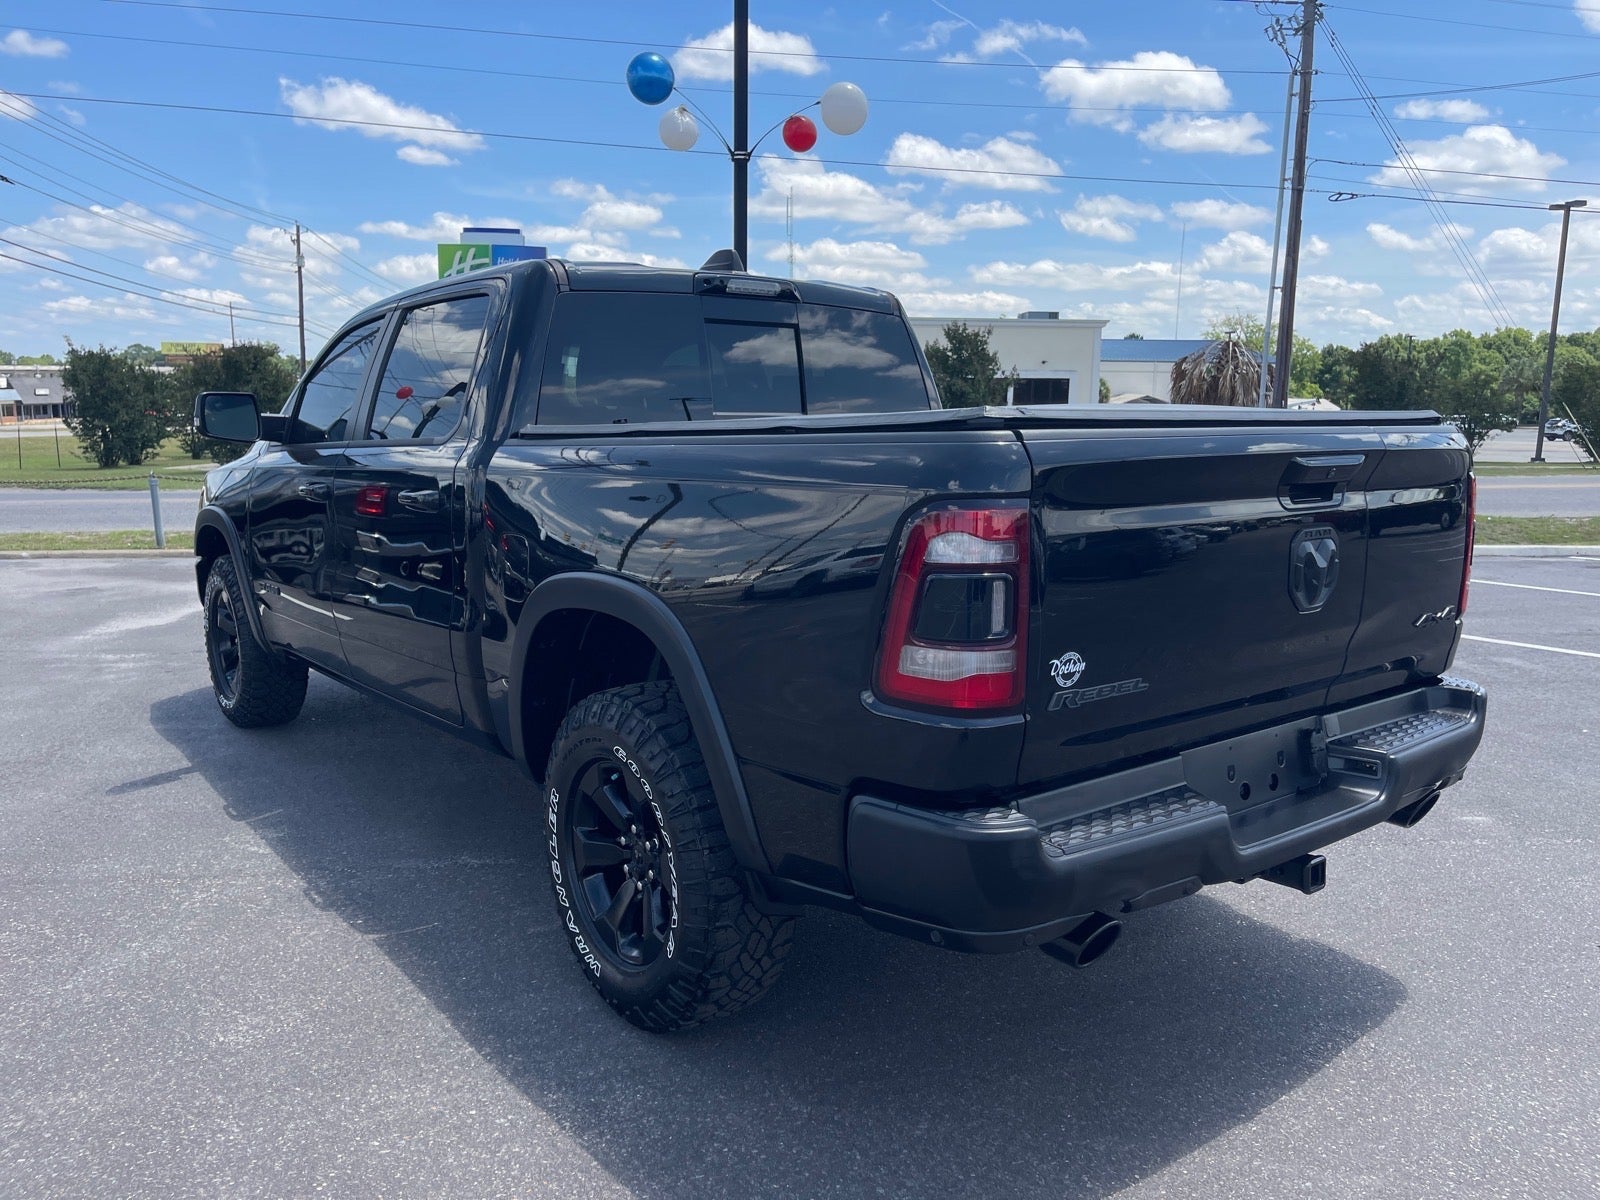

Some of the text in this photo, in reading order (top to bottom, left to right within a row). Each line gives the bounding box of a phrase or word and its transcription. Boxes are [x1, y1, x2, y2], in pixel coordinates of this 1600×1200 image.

[1304, 528, 1332, 538] RAM
[1048, 659, 1086, 676] Dothan
[548, 788, 601, 977] WRANGLER
[613, 746, 678, 959] GOODYEAR
